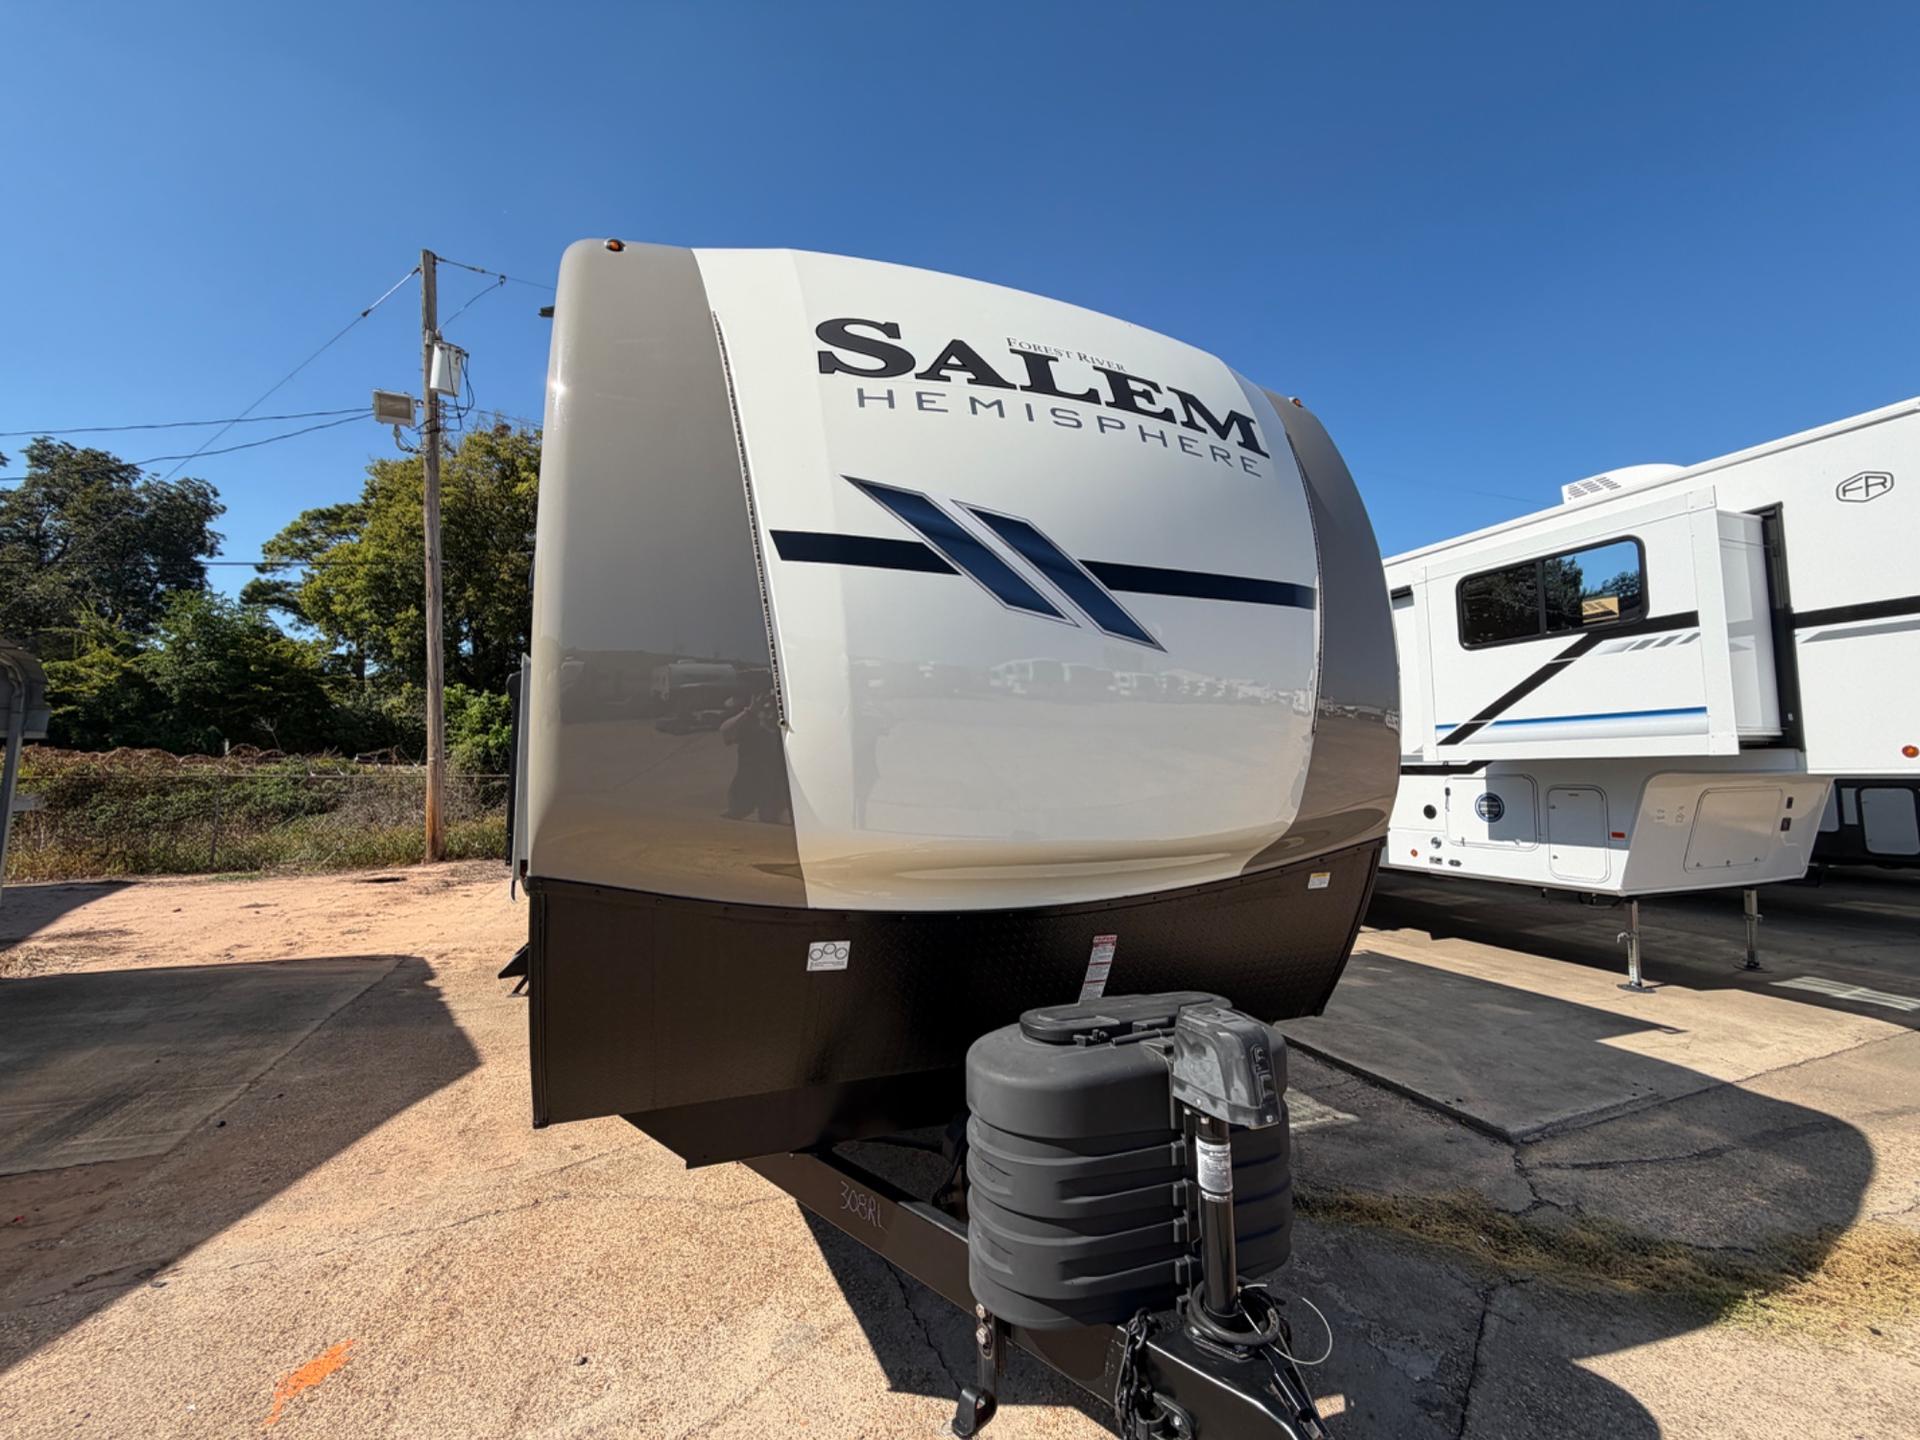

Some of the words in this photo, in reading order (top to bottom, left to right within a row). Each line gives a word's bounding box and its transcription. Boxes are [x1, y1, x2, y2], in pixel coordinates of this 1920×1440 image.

[1006, 337, 1072, 359] FOREST
[1077, 351, 1127, 372] RIVER
[815, 317, 1270, 459] SALEM
[856, 387, 1263, 478] HEMISPHERE
[1842, 475, 1888, 498] FR
